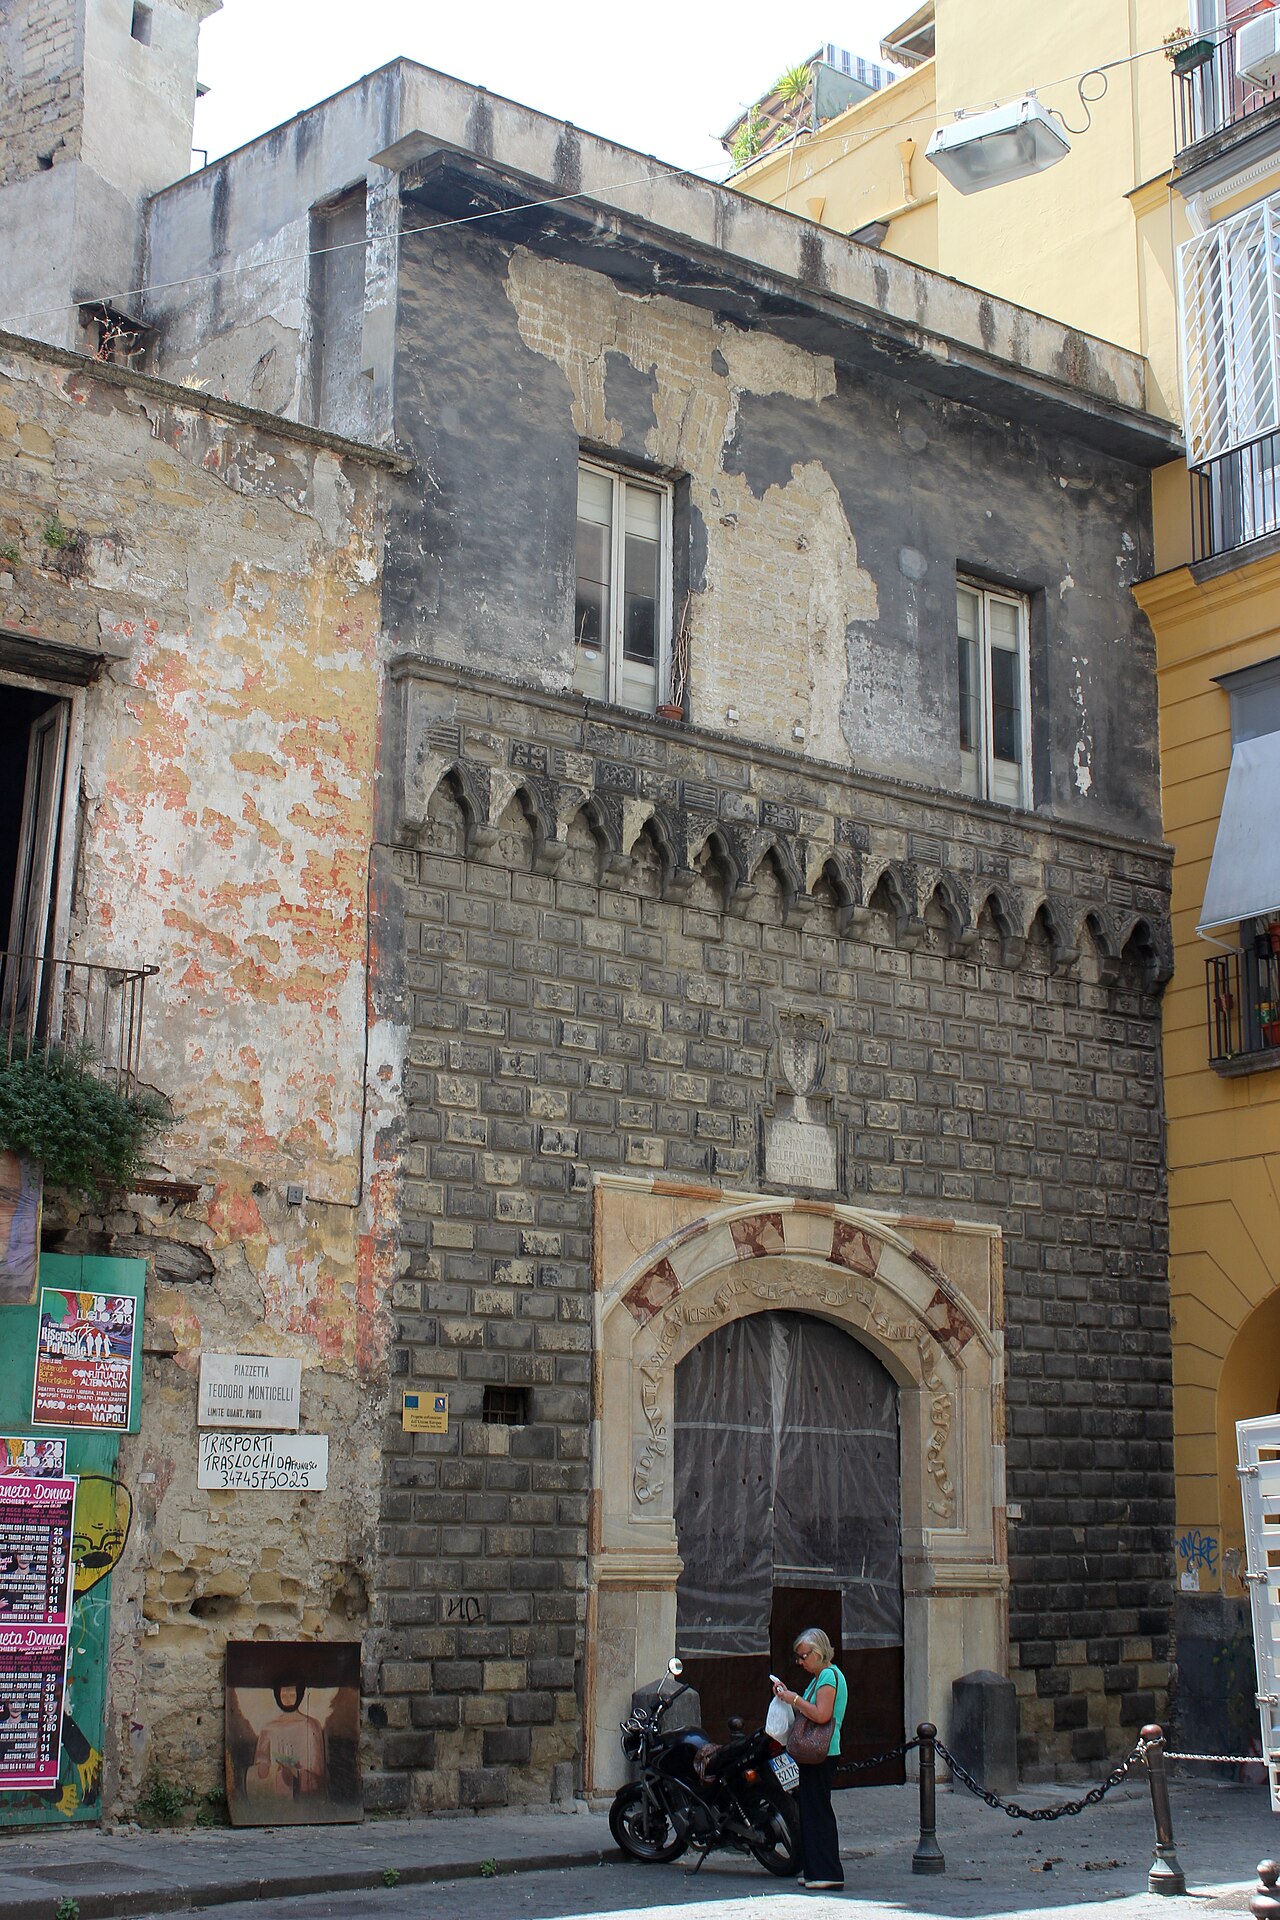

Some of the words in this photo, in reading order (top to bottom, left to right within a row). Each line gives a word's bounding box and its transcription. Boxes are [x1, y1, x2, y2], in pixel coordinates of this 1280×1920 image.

[93, 1296, 106, 1312] 18
[115, 1298, 133, 1314] 28
[77, 1310, 110, 1322] LUGLIO
[112, 1313, 132, 1324] 2013
[234, 1364, 269, 1378] PIAZZETTA
[208, 1383, 244, 1399] TEODORO
[248, 1385, 293, 1401] MONTICELLI
[37, 1400, 65, 1410] PARCO
[207, 1407, 224, 1417] LIMITE
[93, 1412, 126, 1424] NAPOLI
[22, 1440, 36, 1457] 18
[44, 1441, 63, 1458] 28
[7, 1456, 40, 1467] LUGLIO
[42, 1457, 62, 1469] 2013
[277, 1456, 292, 1470] DA
[220, 1470, 309, 1489] 3474575025
[33, 1483, 72, 1500] Donna
[53, 1527, 63, 1535] 25
[53, 1537, 62, 1545] 30
[52, 1547, 61, 1555] 38
[50, 1567, 65, 1575] 7,50
[48, 1596, 58, 1604] 91
[48, 1605, 58, 1613] 36
[47, 1615, 53, 1623] 6
[25, 1630, 65, 1646] Donna
[46, 1674, 56, 1682] 25
[43, 1714, 57, 1722] 7,50
[42, 1734, 51, 1742] 11
[775, 1755, 786, 1767] CK
[39, 1764, 45, 1772] 6
